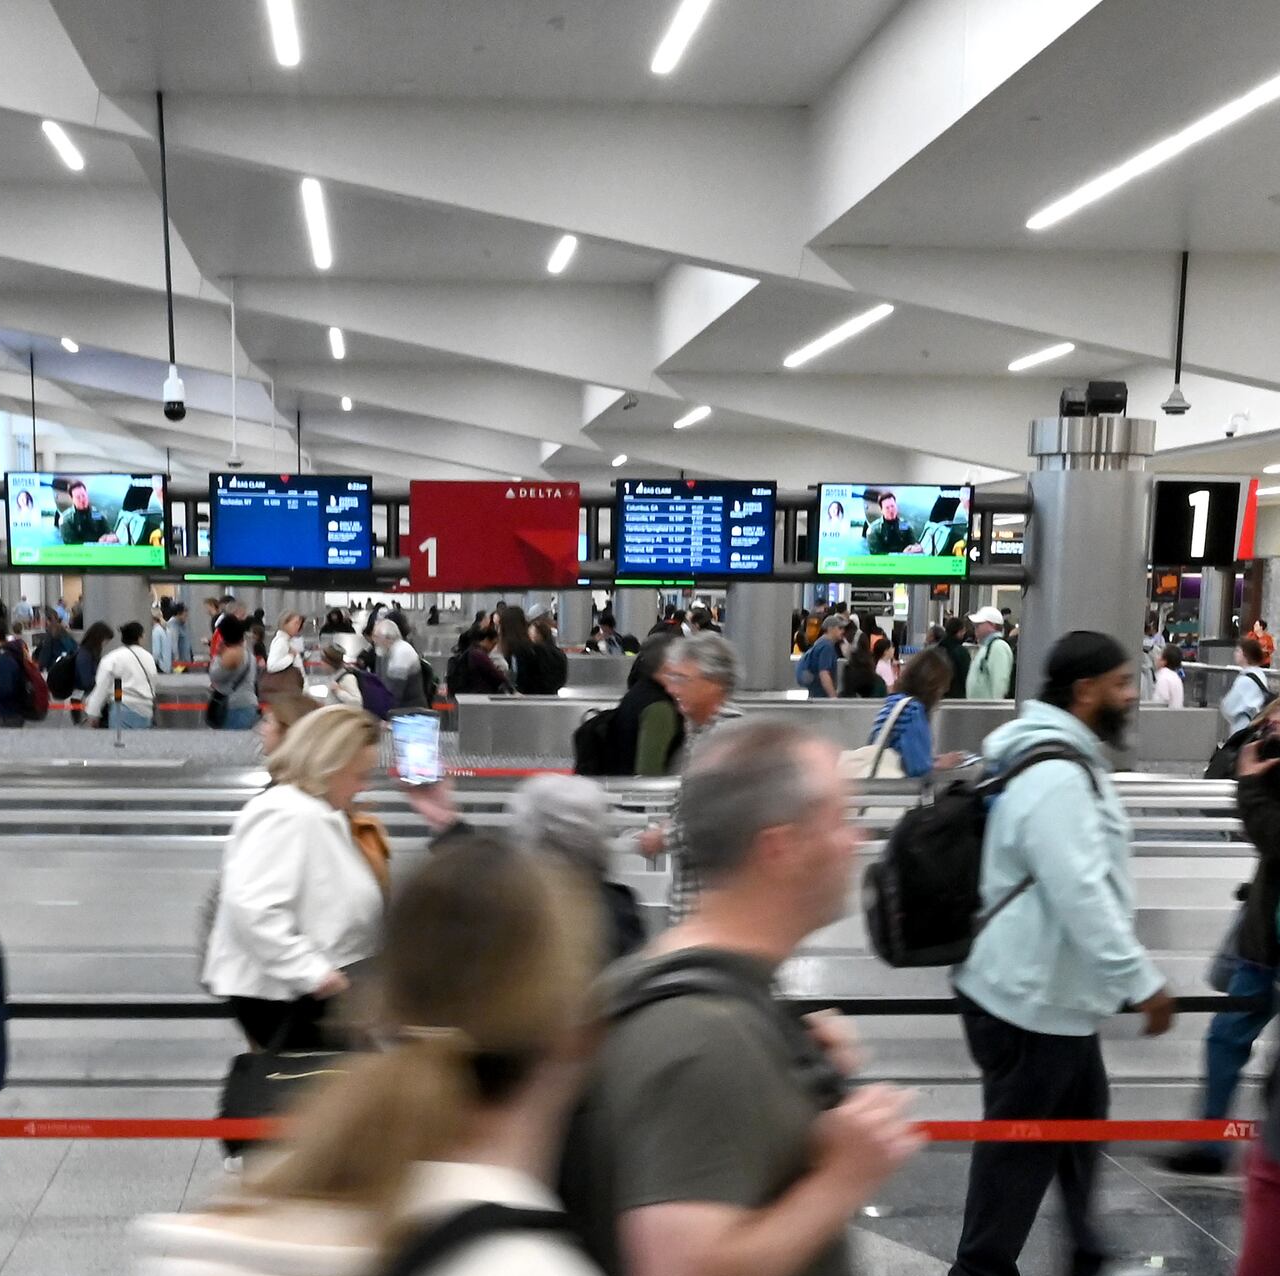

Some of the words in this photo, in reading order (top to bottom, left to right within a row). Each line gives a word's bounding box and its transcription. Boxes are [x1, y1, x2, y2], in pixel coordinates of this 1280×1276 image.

[519, 488, 562, 499] DELTA
[1188, 490, 1210, 558] 1
[418, 537, 437, 578] 1
[1223, 1122, 1261, 1137] ATL
